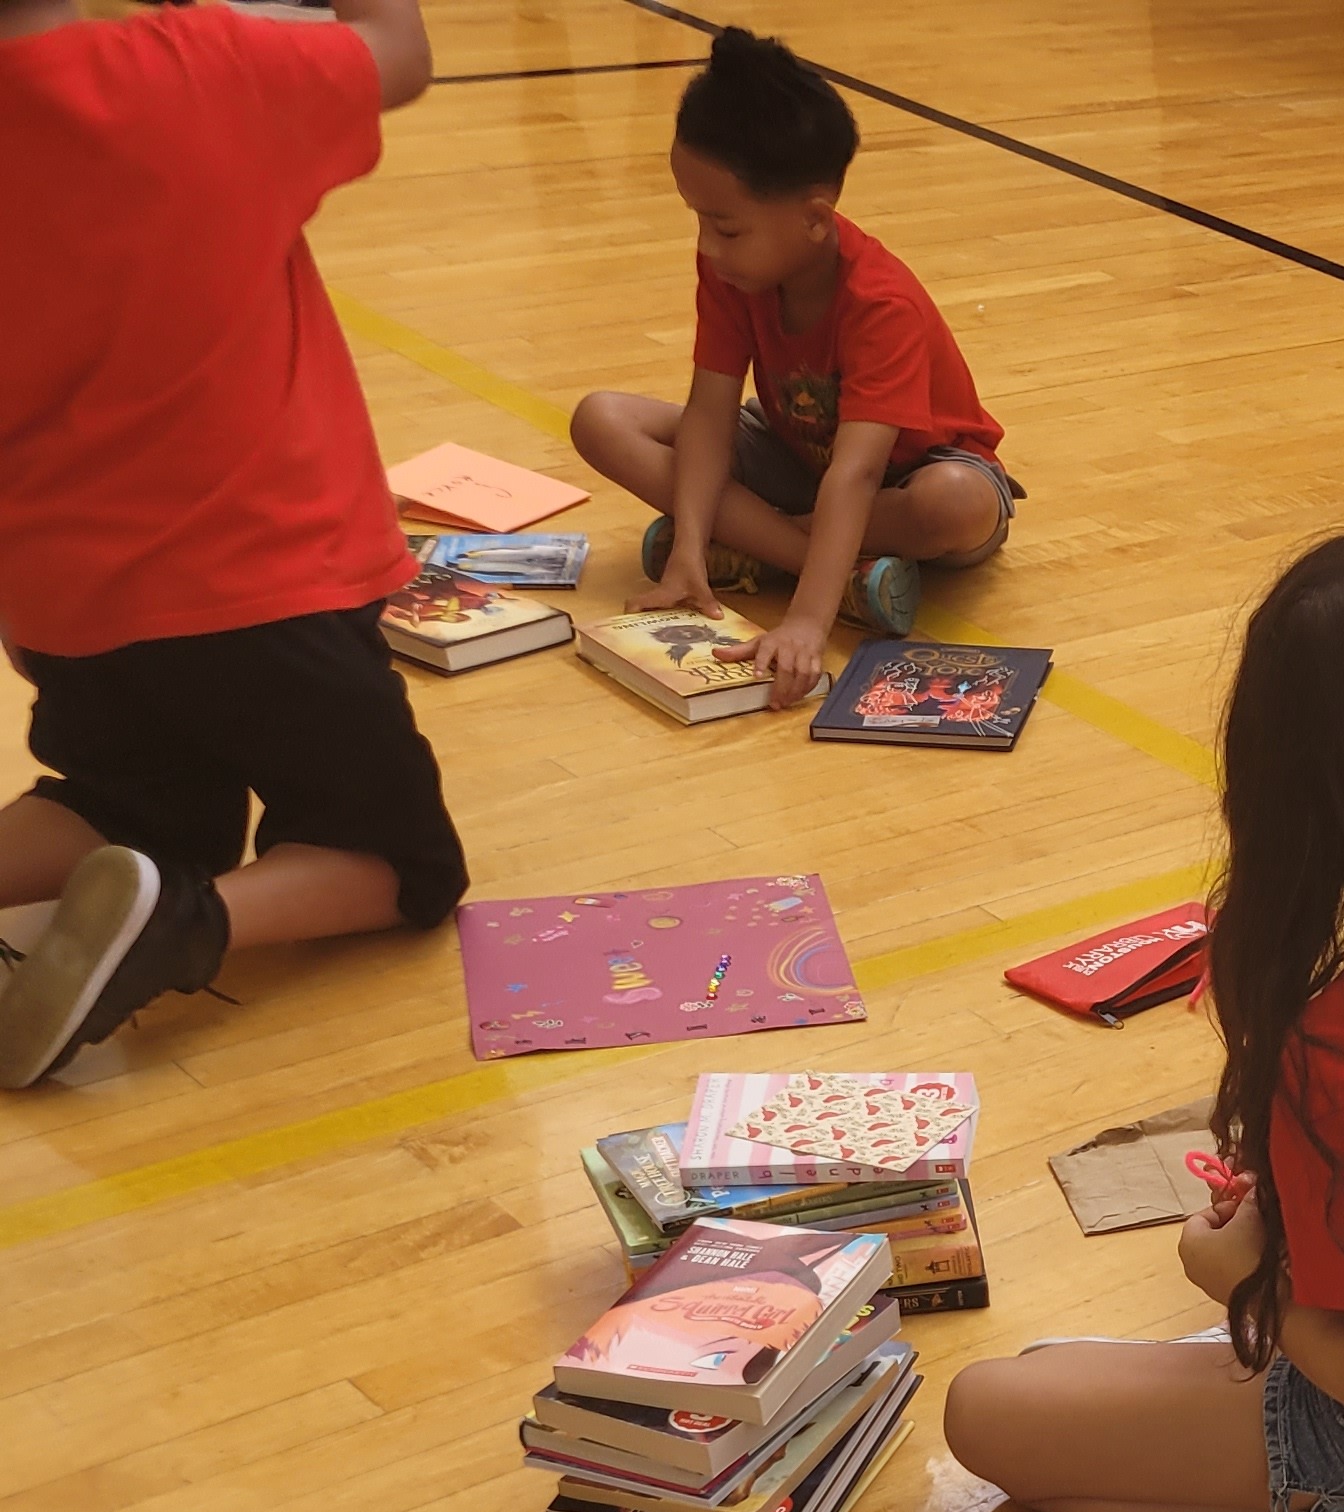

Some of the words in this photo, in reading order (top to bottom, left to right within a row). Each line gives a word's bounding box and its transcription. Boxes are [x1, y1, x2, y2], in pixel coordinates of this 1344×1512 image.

[1073, 934, 1155, 968] LIBRARY
[1088, 937, 1165, 971] HOUSTON
[689, 1125, 710, 1161] SHARON
[691, 1171, 740, 1181] DRAPER
[687, 1246, 731, 1259] SHANNON
[730, 1251, 756, 1261] HALE
[691, 1254, 721, 1266] DEAN
[720, 1258, 750, 1269] HALE
[650, 1295, 751, 1318] Squirrel
[752, 1305, 797, 1325] Girl
